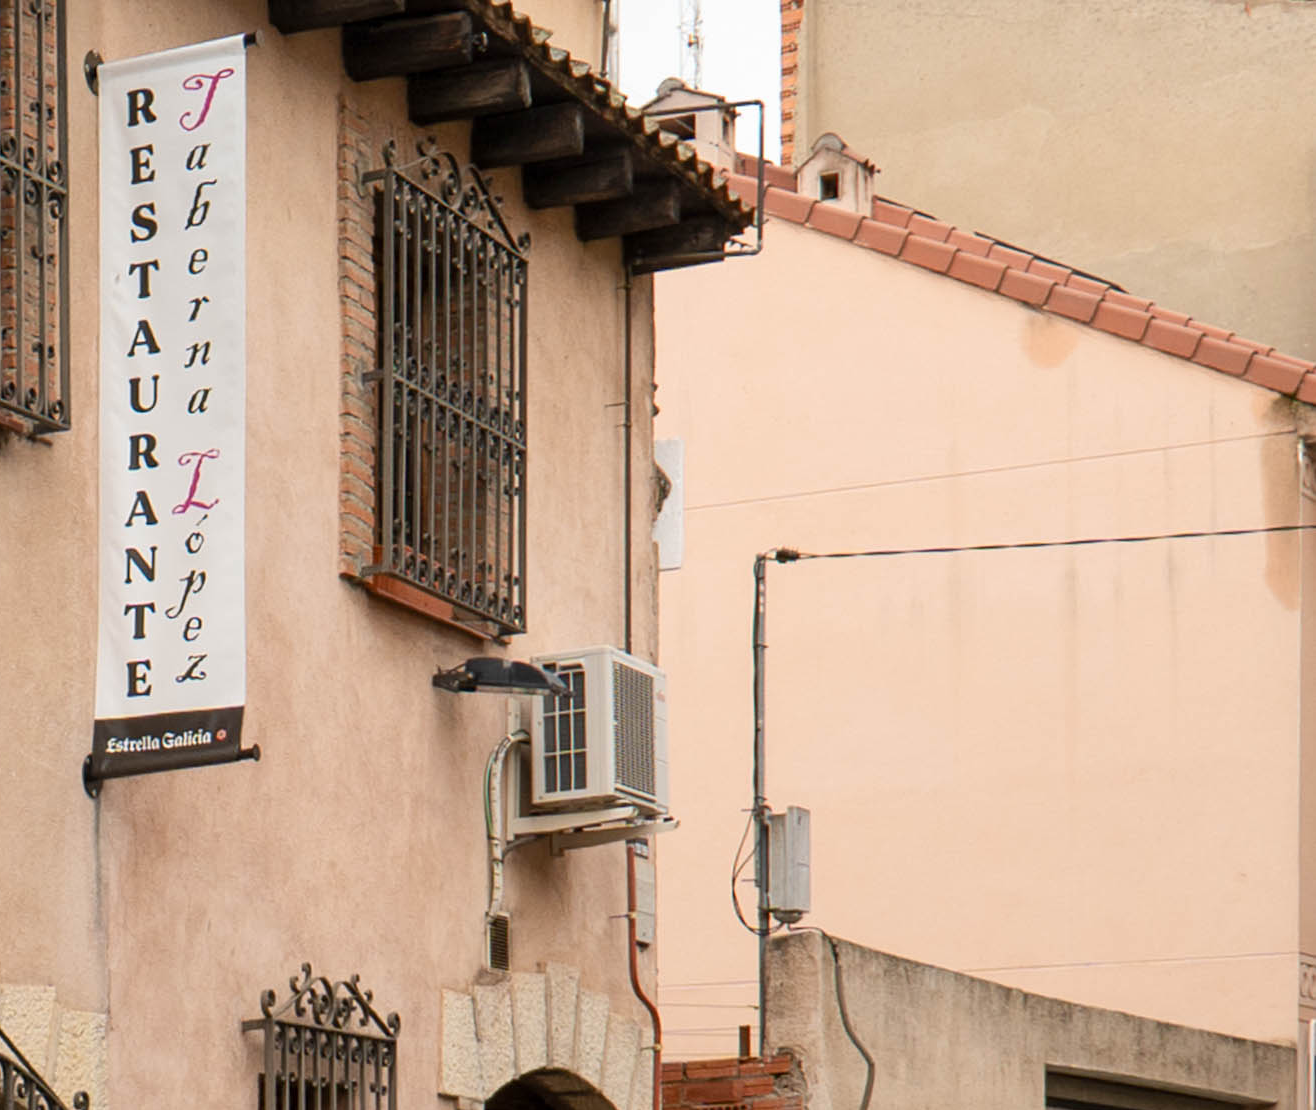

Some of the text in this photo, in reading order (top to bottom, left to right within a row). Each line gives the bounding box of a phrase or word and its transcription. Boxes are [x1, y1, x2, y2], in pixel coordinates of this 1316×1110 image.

[124, 88, 161, 697] RESTAURANTE
[165, 68, 234, 683] Taberna López
[105, 728, 212, 753] Estrella Galicia
